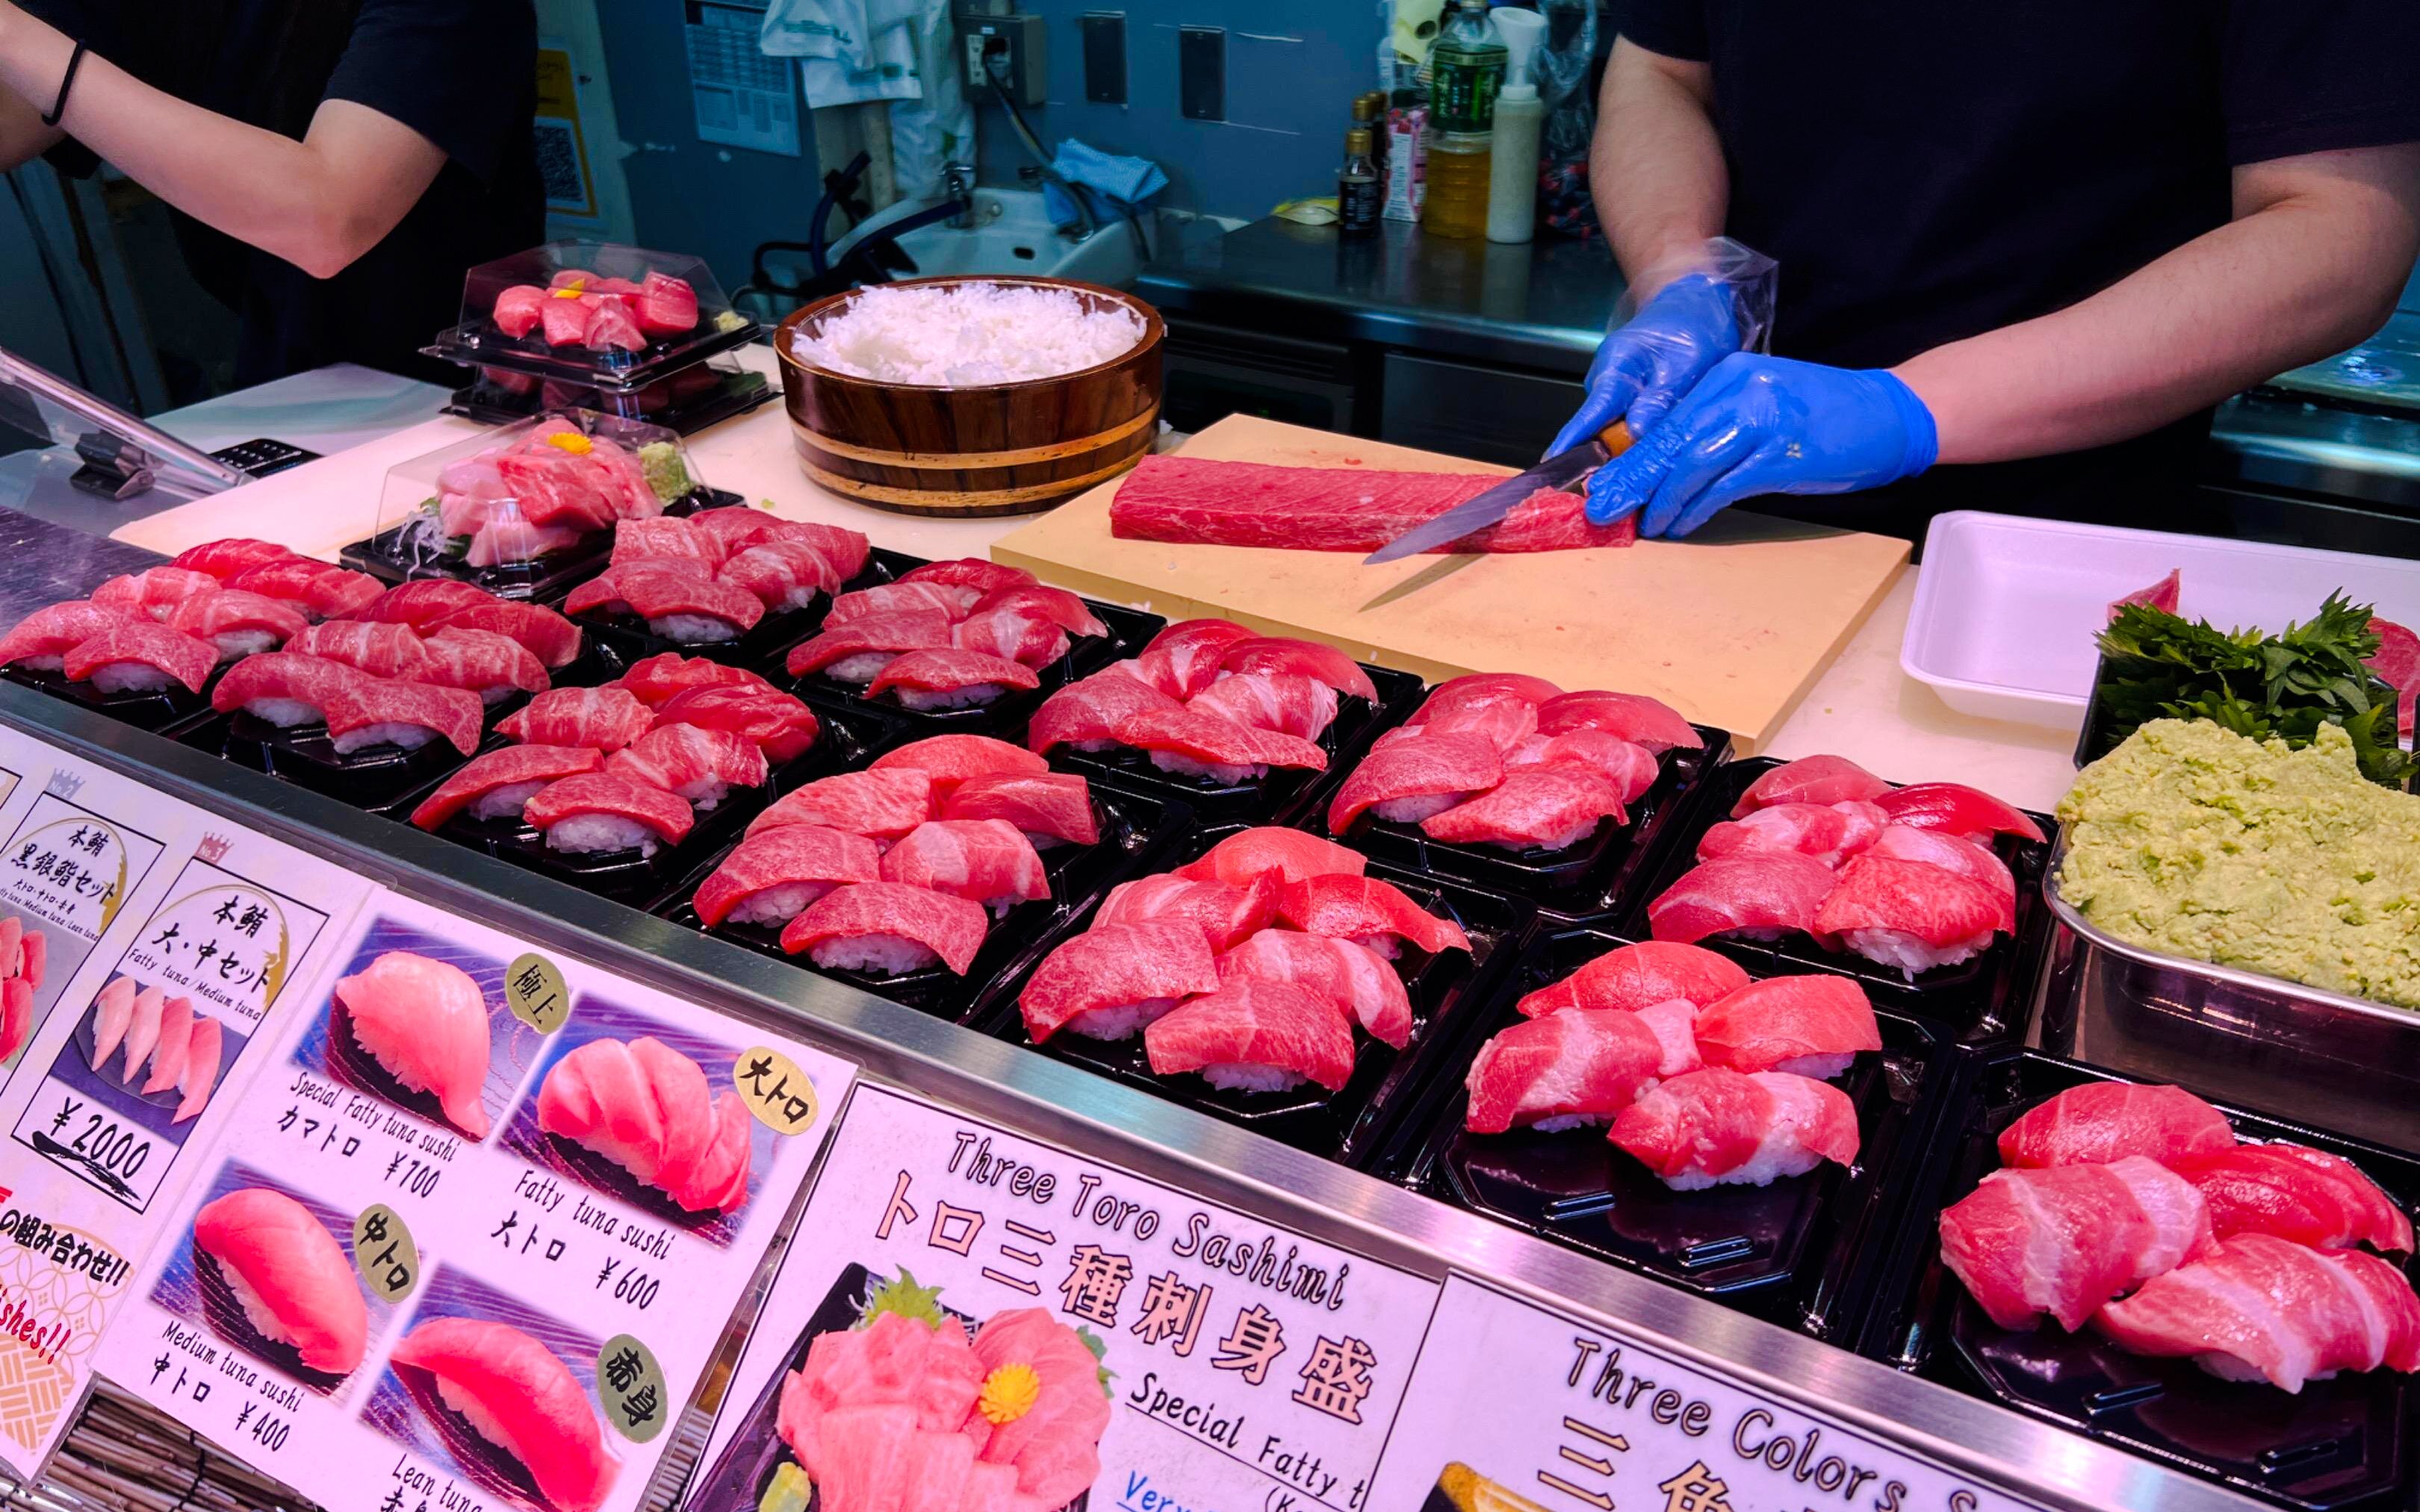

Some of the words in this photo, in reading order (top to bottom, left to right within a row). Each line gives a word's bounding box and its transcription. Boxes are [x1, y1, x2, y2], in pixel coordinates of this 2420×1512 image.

[10, 842, 115, 904] 黒銀鮨セット
[69, 825, 108, 857] 本鮪
[199, 845, 223, 860] No.3
[152, 922, 268, 993] 大・中セット
[213, 895, 268, 939] 本鮪
[128, 948, 158, 971] Fatty
[234, 998, 261, 1021] tuna
[291, 1071, 344, 1108] Special
[344, 1095, 382, 1129] Fatty
[382, 1111, 418, 1144] tuna
[418, 1136, 461, 1162] sushi
[739, 1056, 809, 1124] 大トロ
[278, 1105, 361, 1157] カマトロ
[384, 1151, 441, 1198] ¥700
[359, 1212, 410, 1292] 中トロ
[515, 1169, 565, 1213] Fatty
[573, 1195, 618, 1235] tuna
[620, 1225, 676, 1260] sushi
[946, 1130, 1058, 1204] Three
[1070, 1174, 1161, 1241] Toro
[1172, 1210, 1350, 1310] Sashimi
[491, 1210, 566, 1261] 大トロ
[596, 1257, 660, 1310] ¥600
[875, 1169, 1378, 1425] トロ三種刺身盛
[150, 1352, 211, 1403] 中トロ
[235, 1401, 291, 1452] ¥400
[162, 1320, 217, 1365] Medium
[219, 1351, 258, 1387] tuna
[260, 1380, 305, 1413] sushi
[606, 1346, 657, 1427] 赤身
[1130, 1372, 1245, 1449] Special
[1258, 1435, 1338, 1496] Fatty
[1566, 1337, 1712, 1437] Three
[1732, 1408, 1908, 1512] Colors
[392, 1453, 436, 1496] Lean
[1126, 1469, 1191, 1512] Ver
